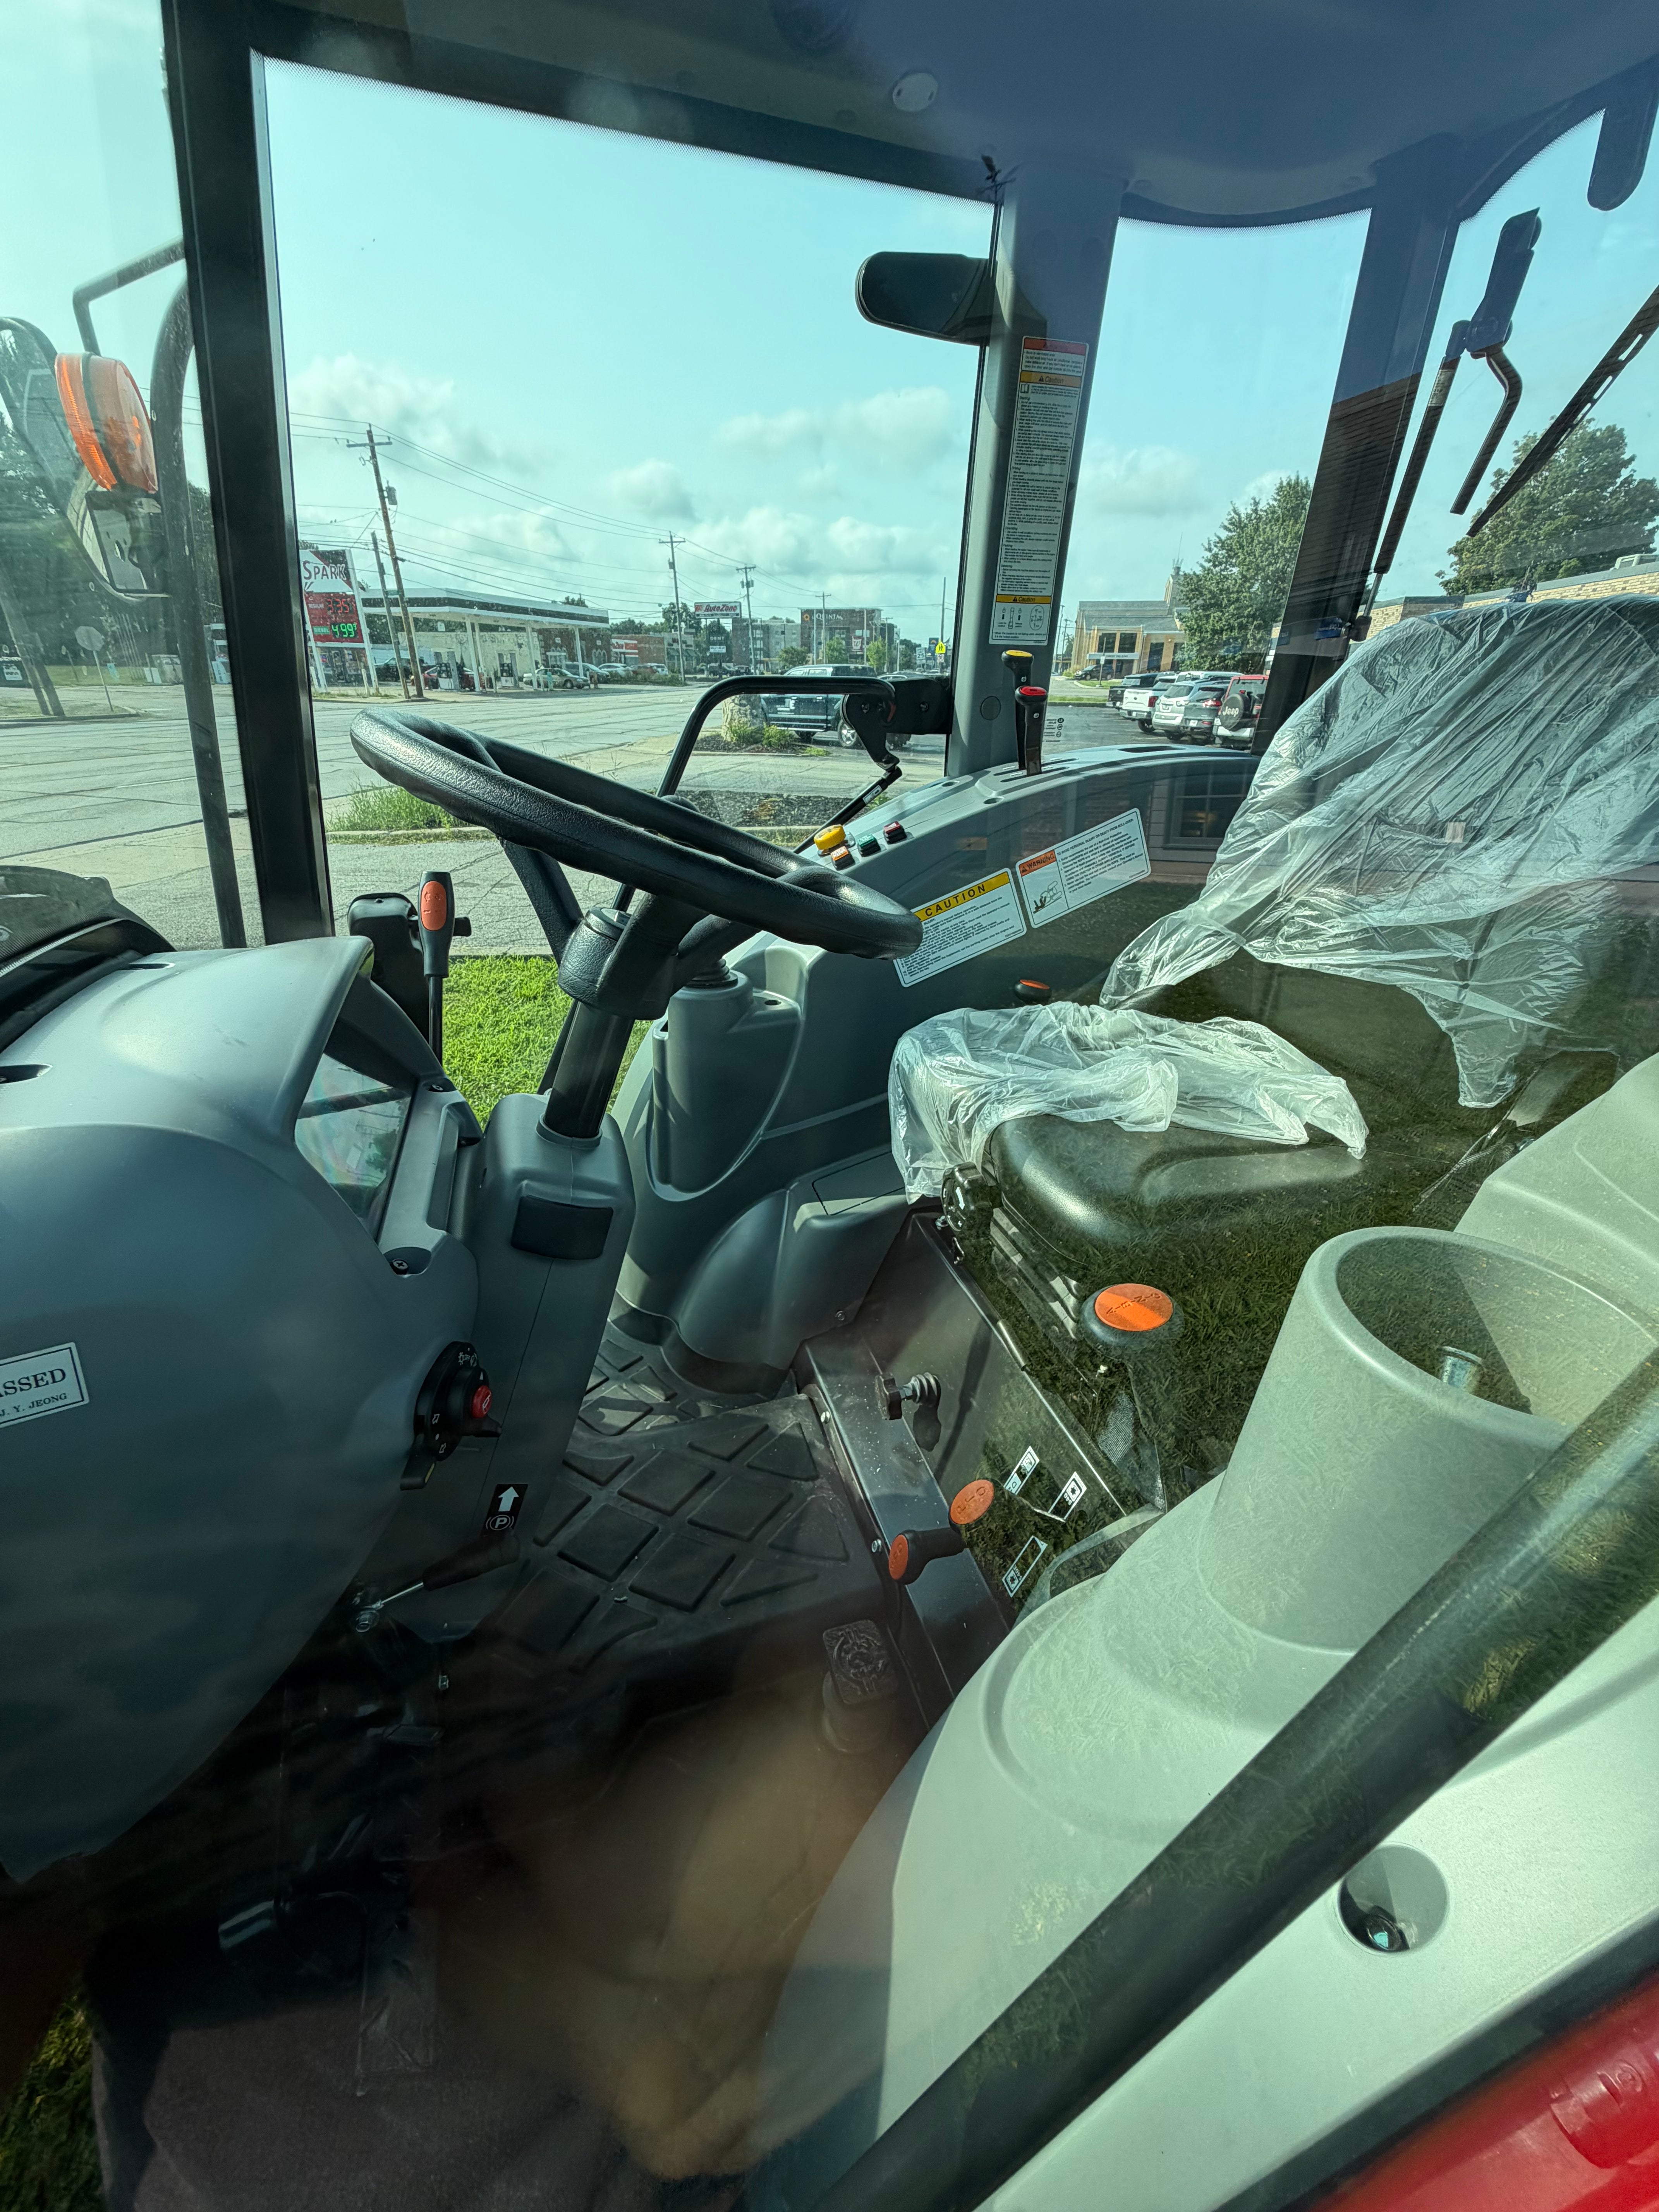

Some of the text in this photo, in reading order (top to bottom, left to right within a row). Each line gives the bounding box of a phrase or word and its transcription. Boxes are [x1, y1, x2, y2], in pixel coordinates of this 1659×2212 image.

[302, 560, 347, 580] SPARK
[704, 604, 737, 612] AutoZone
[1222, 706, 1240, 718] Jeep
[1027, 852, 1055, 871] WARNING
[925, 884, 986, 917] CAUTION
[13, 1405, 25, 1413] Y.
[29, 1393, 67, 1409] JEONG
